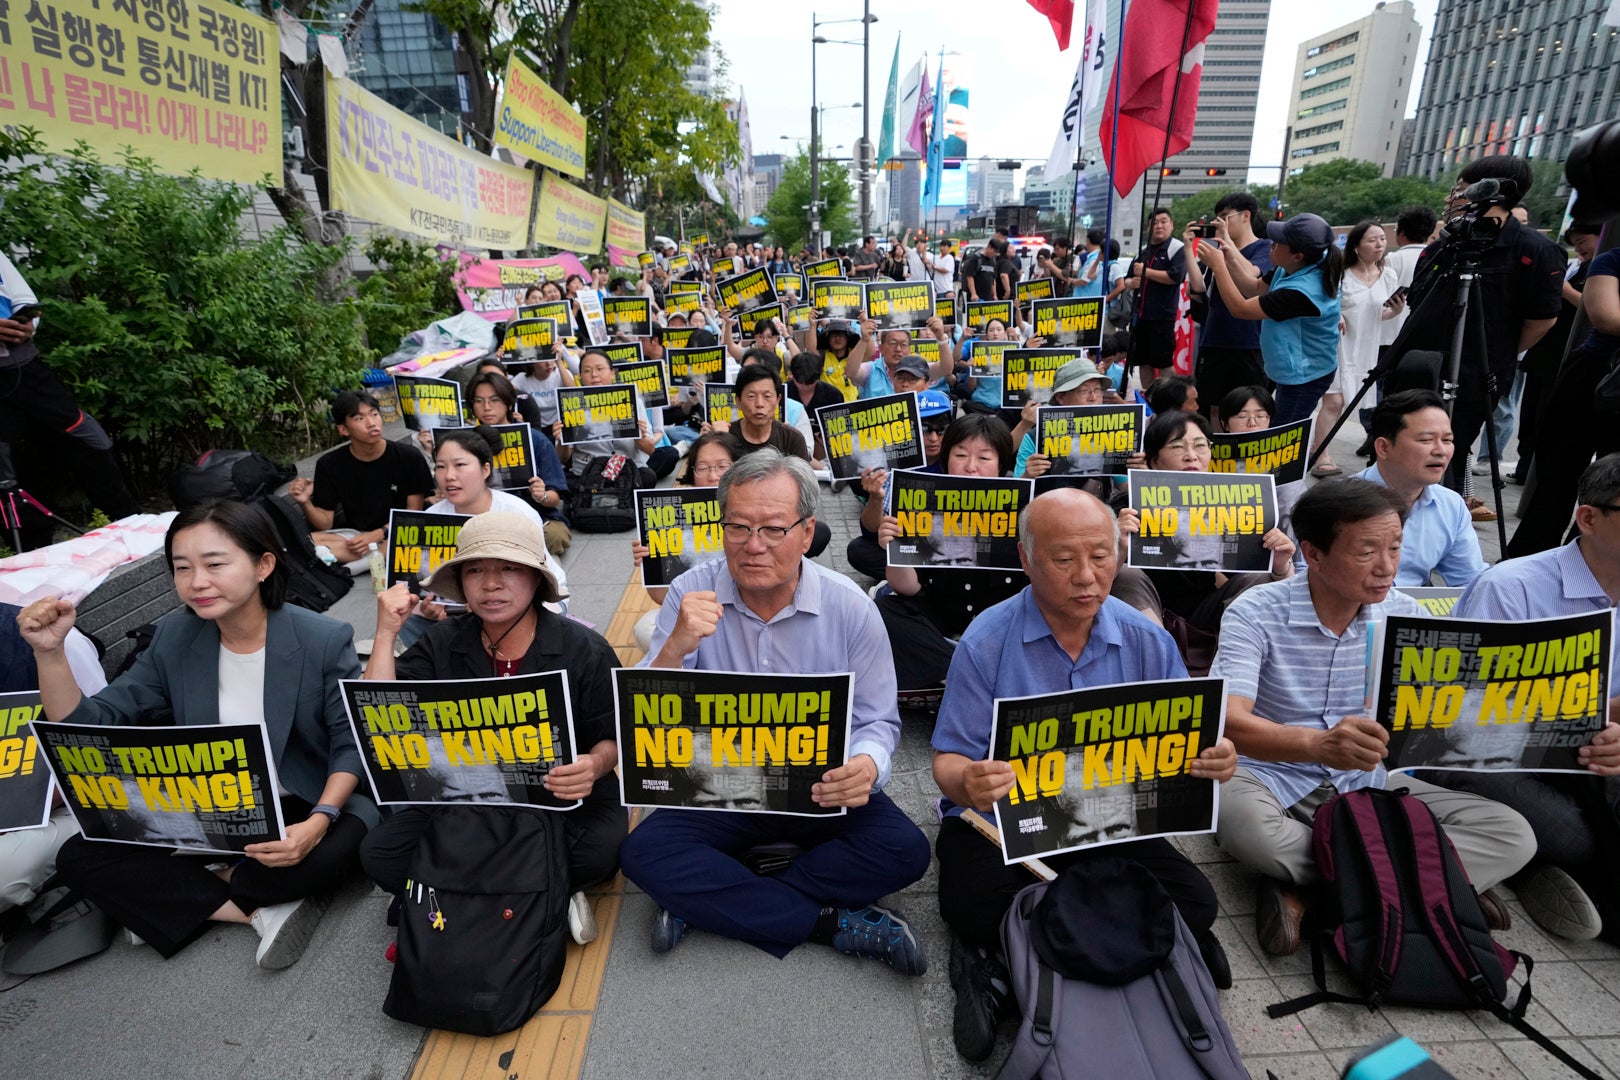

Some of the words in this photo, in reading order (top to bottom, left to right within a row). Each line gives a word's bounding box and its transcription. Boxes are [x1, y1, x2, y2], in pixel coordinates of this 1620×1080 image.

[198, 5, 265, 65] 국정원!
[25, 0, 125, 76] 실행한
[137, 36, 230, 104] 통신재벌
[239, 71, 267, 110] KT!
[21, 61, 56, 118] 나
[64, 73, 151, 134] 몰라라!
[157, 97, 199, 145] 이게
[204, 108, 268, 154] 나라냐?
[500, 106, 536, 146] Support
[338, 94, 418, 187] KT민주노조
[722, 286, 733, 299] NO
[734, 271, 765, 291] TRUMP!
[724, 293, 740, 309] NO
[739, 279, 769, 300] KING!
[816, 286, 828, 297] NO
[830, 286, 860, 296] TRUMP!
[869, 290, 885, 303] NO
[889, 286, 928, 301] TRUMP!
[605, 303, 614, 313] NO
[615, 301, 646, 313] TRUMP!
[815, 294, 829, 309] NO
[833, 293, 860, 306] KING!
[870, 299, 888, 316] NO
[894, 295, 929, 311] KING!
[969, 307, 980, 316] NO
[981, 304, 1008, 315] TRUMP!
[1038, 307, 1054, 321] NO
[1057, 302, 1098, 318] TRUMP!
[606, 311, 616, 324] NO
[618, 308, 646, 323] KING!
[741, 313, 751, 322] NO
[742, 319, 755, 331] NO
[969, 314, 982, 326] NO
[1037, 317, 1057, 336] NO
[1059, 313, 1098, 332] KING!
[516, 322, 551, 337] TRUMP!
[519, 331, 553, 347] KING!
[605, 347, 638, 362] RUMP!
[672, 355, 685, 366] NO
[688, 350, 722, 363] TRUMP!
[918, 343, 939, 353] TRUM
[920, 349, 942, 362] KIN
[974, 346, 986, 356] NO
[672, 363, 689, 376] NO
[691, 359, 722, 375] KING!
[973, 354, 988, 367] NO
[1008, 359, 1025, 373] NO
[618, 365, 660, 384] TRUMP!
[635, 375, 661, 393] NG!
[1007, 372, 1028, 390] NO
[399, 384, 412, 399] NO
[414, 384, 455, 401] TRUMP!
[562, 397, 581, 412] NO
[584, 390, 632, 410] TRUMP!
[710, 394, 728, 408] NO
[401, 398, 414, 414] NO
[419, 398, 457, 415] KING!
[563, 409, 585, 427] NO
[590, 403, 633, 422] KING!
[710, 406, 732, 424] NO
[827, 416, 849, 437] NO
[849, 401, 912, 433] TRUMP!
[1045, 419, 1068, 438] NO
[1074, 412, 1135, 434] TRUMP!
[829, 432, 852, 458] NO
[858, 419, 912, 451] KING!
[1044, 434, 1072, 458] NO
[1080, 429, 1134, 454] KING!
[1238, 427, 1302, 457] TRUMP!
[493, 446, 525, 469] NG!
[1245, 442, 1300, 474] KING!
[898, 489, 927, 511] NO
[935, 489, 1019, 510] TRUMP!
[1142, 487, 1170, 506] NO
[1180, 485, 1261, 504] TRUMP!
[646, 506, 676, 528] NO
[682, 500, 722, 524] TRU
[897, 511, 933, 537] NO
[943, 512, 1017, 537] KING!
[1140, 508, 1178, 537] NO
[1190, 505, 1264, 536] KING!
[396, 526, 419, 546] NO
[424, 526, 462, 545] TRU
[648, 527, 683, 558] NO
[394, 546, 422, 573] NO
[1396, 628, 1481, 650] 관세폭탄
[1400, 647, 1462, 682] NO
[1477, 629, 1600, 684] TRUMP!
[353, 690, 417, 706] 관세폭탄
[634, 694, 682, 725] NO
[695, 691, 830, 724] TRUMP!
[1393, 684, 1466, 731] NO
[1477, 668, 1599, 726] KING!
[363, 704, 412, 733] NO
[419, 689, 548, 730] TRUMP!
[1010, 718, 1059, 757] NO
[1072, 695, 1203, 744] TRUMP!
[56, 746, 107, 773] NO
[112, 738, 248, 774] TRUMP!
[371, 733, 431, 770] NO
[440, 722, 555, 766] KING!
[635, 727, 694, 768] NO
[710, 725, 829, 767] KING!
[1008, 751, 1067, 805] NO
[1083, 731, 1200, 790] KING!
[69, 775, 128, 810] NO
[136, 770, 256, 813] KING!
